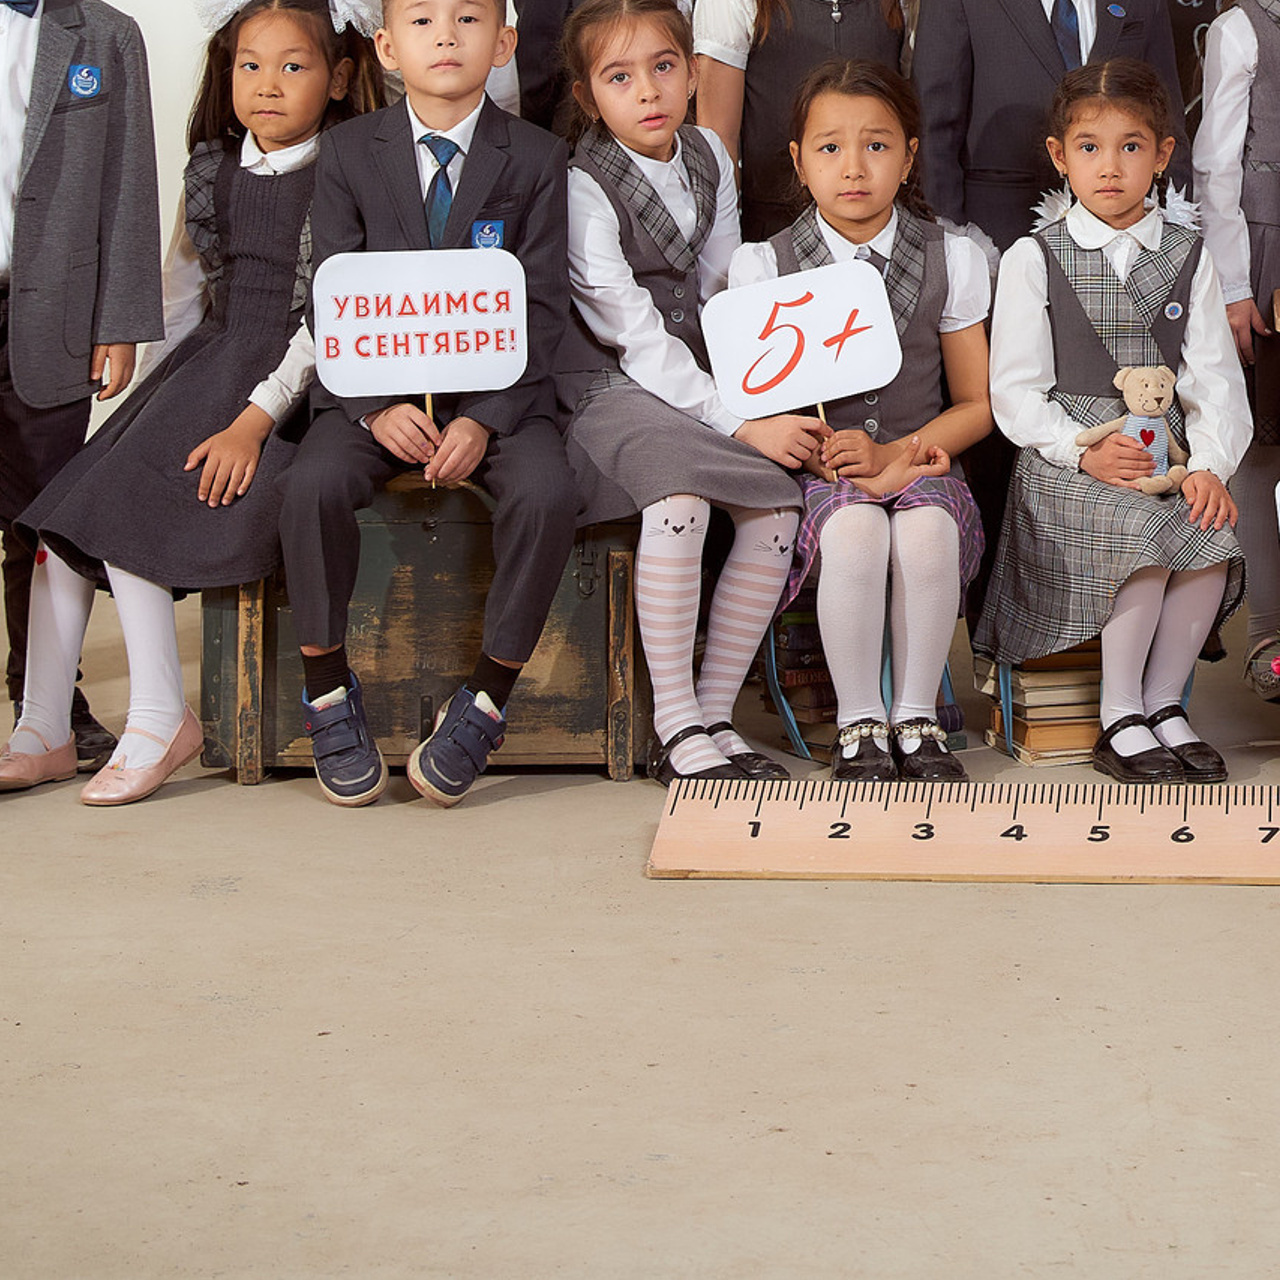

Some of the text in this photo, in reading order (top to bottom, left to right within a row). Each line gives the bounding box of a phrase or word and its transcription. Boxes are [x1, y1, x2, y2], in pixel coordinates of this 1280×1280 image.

[331, 288, 512, 320] УВИДИМСЯ
[324, 326, 518, 361] В СЕНТЯБРЕ!
[748, 821, 761, 838] 1
[828, 822, 851, 839] 2
[911, 823, 935, 840] 3
[1000, 824, 1028, 841] 4
[1087, 825, 1110, 842] 5
[1170, 826, 1195, 843] 6
[1258, 827, 1280, 844] 7
